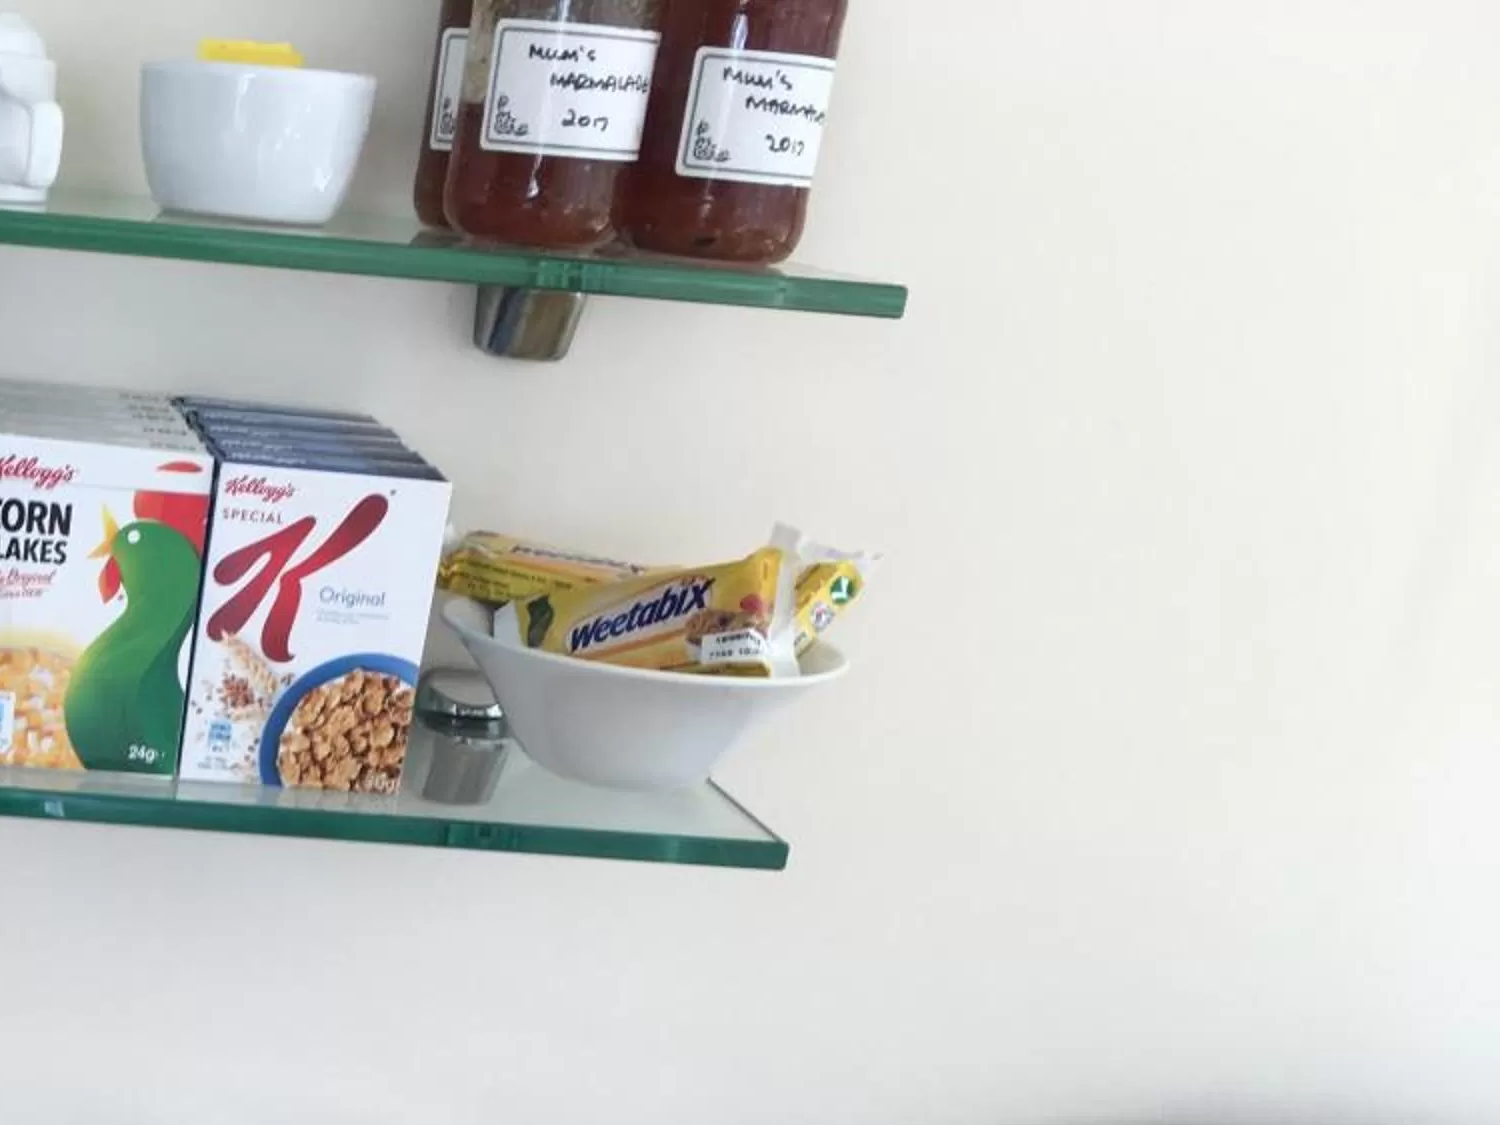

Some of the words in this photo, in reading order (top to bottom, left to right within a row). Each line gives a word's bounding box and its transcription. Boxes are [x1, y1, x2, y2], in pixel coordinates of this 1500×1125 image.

[560, 107, 609, 132] 2017
[764, 133, 805, 157] 2017
[224, 474, 296, 503] Kellogg's
[223, 506, 284, 525] SPECIAL
[206, 493, 389, 663] K
[320, 585, 386, 609] Original
[569, 576, 716, 653] Weetabix
[128, 744, 155, 763] 24g
